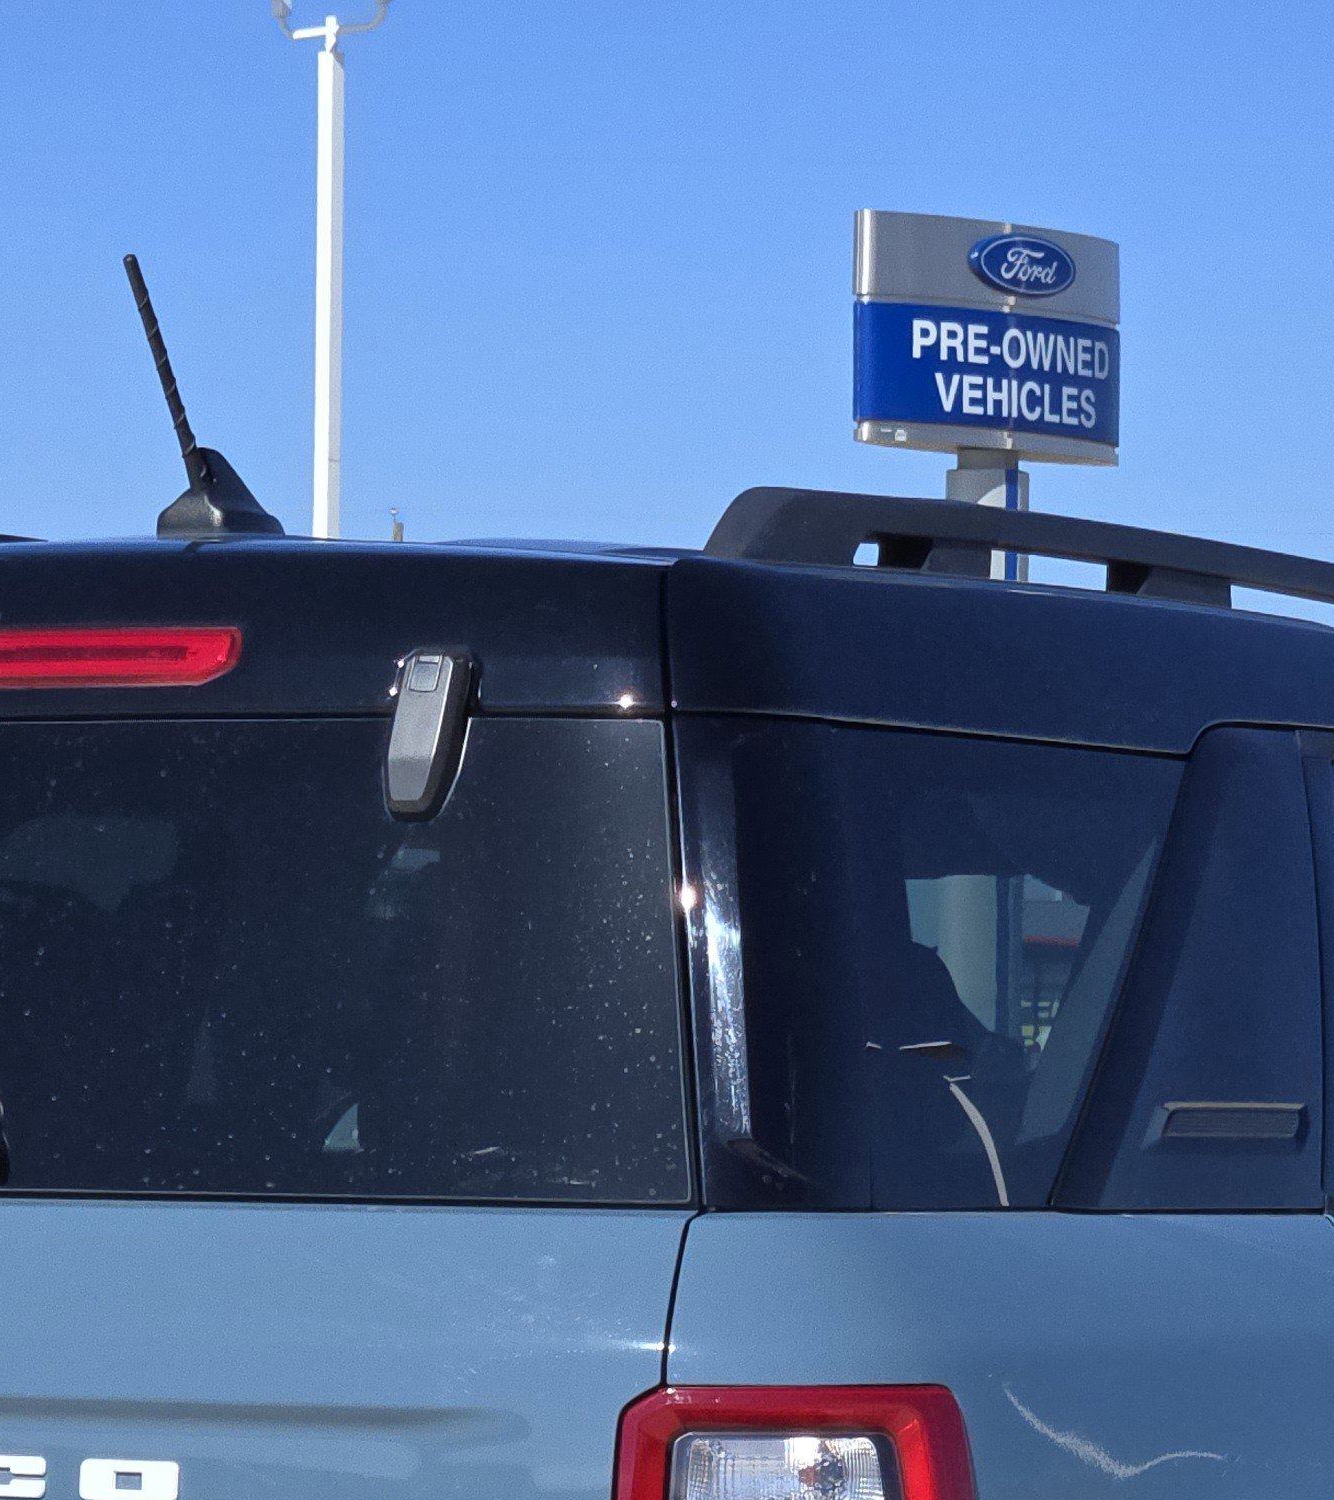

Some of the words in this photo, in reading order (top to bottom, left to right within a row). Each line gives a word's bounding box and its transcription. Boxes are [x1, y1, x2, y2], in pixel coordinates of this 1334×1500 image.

[1000, 246, 1058, 285] Ford
[911, 318, 1109, 380] PRE-OWNED
[934, 372, 1096, 429] VEHICLES
